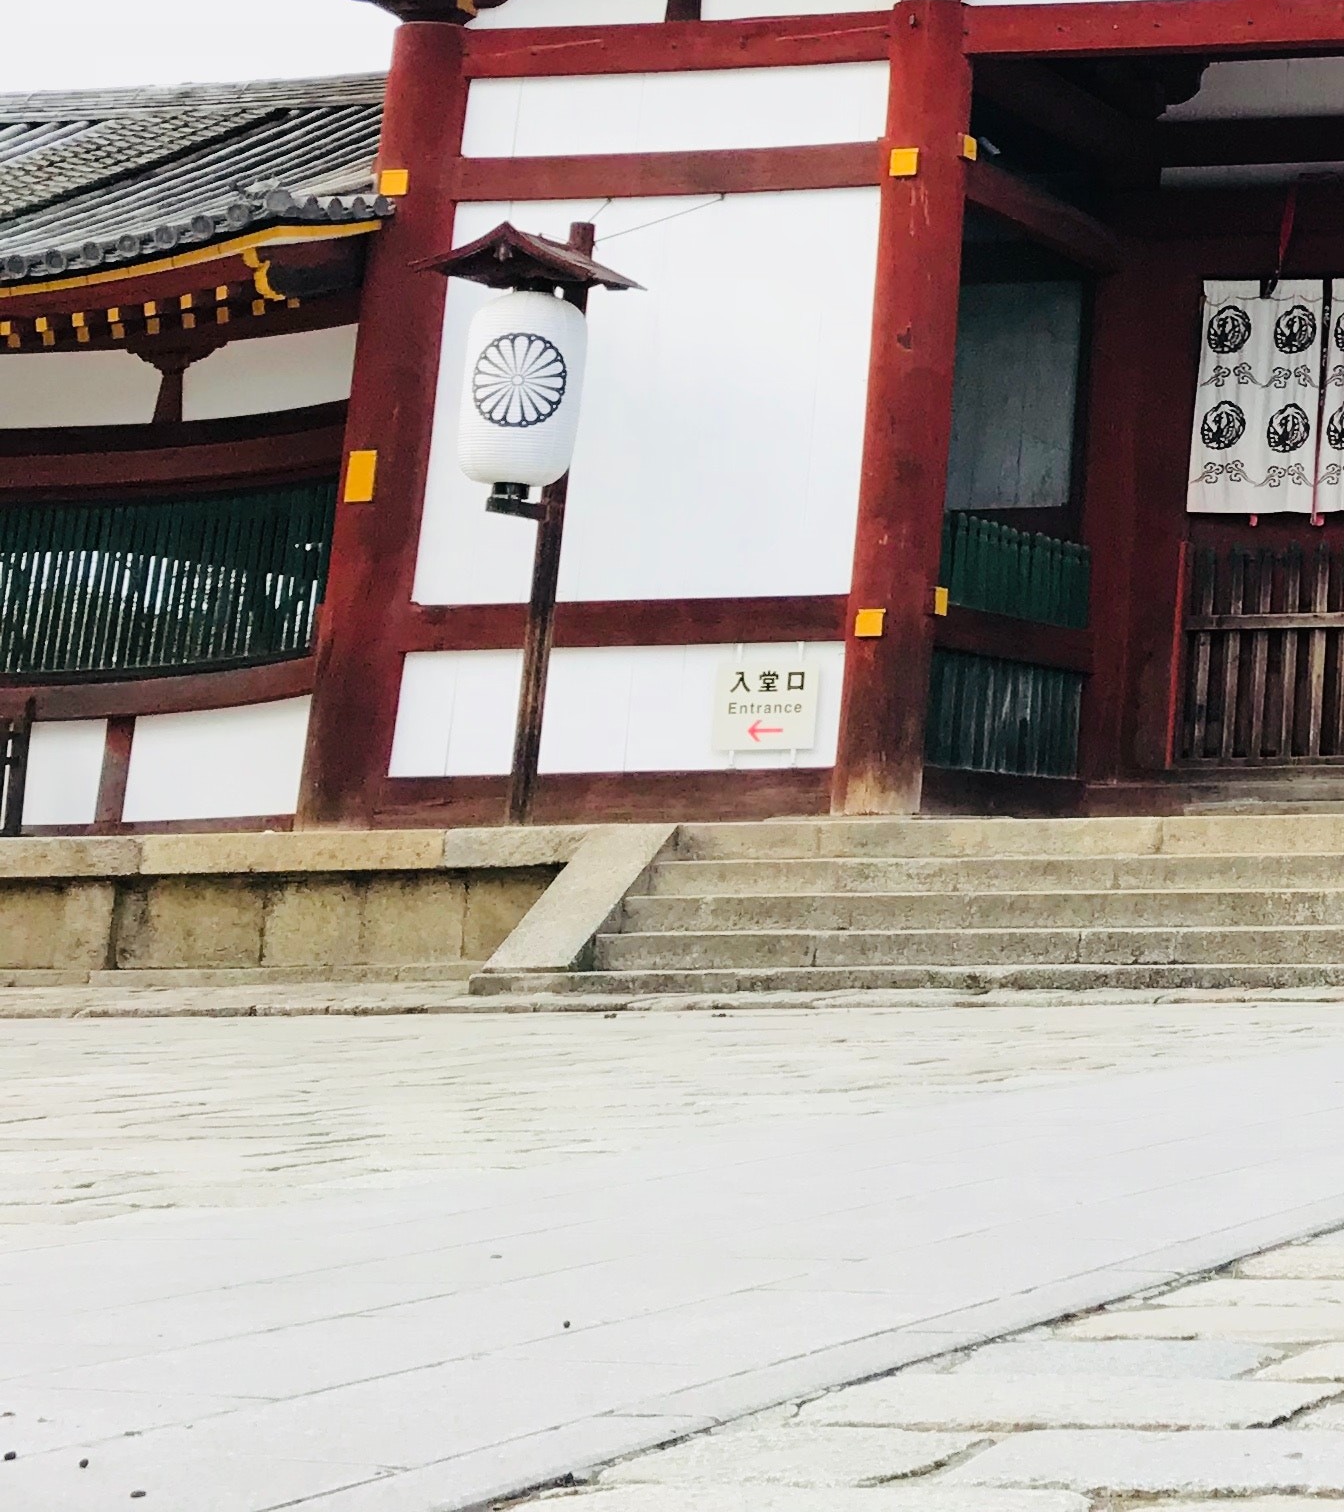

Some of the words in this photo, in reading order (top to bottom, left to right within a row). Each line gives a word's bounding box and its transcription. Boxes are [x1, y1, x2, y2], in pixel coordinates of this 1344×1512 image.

[730, 670, 805, 693] 入堂口
[728, 702, 802, 714] Entrance
